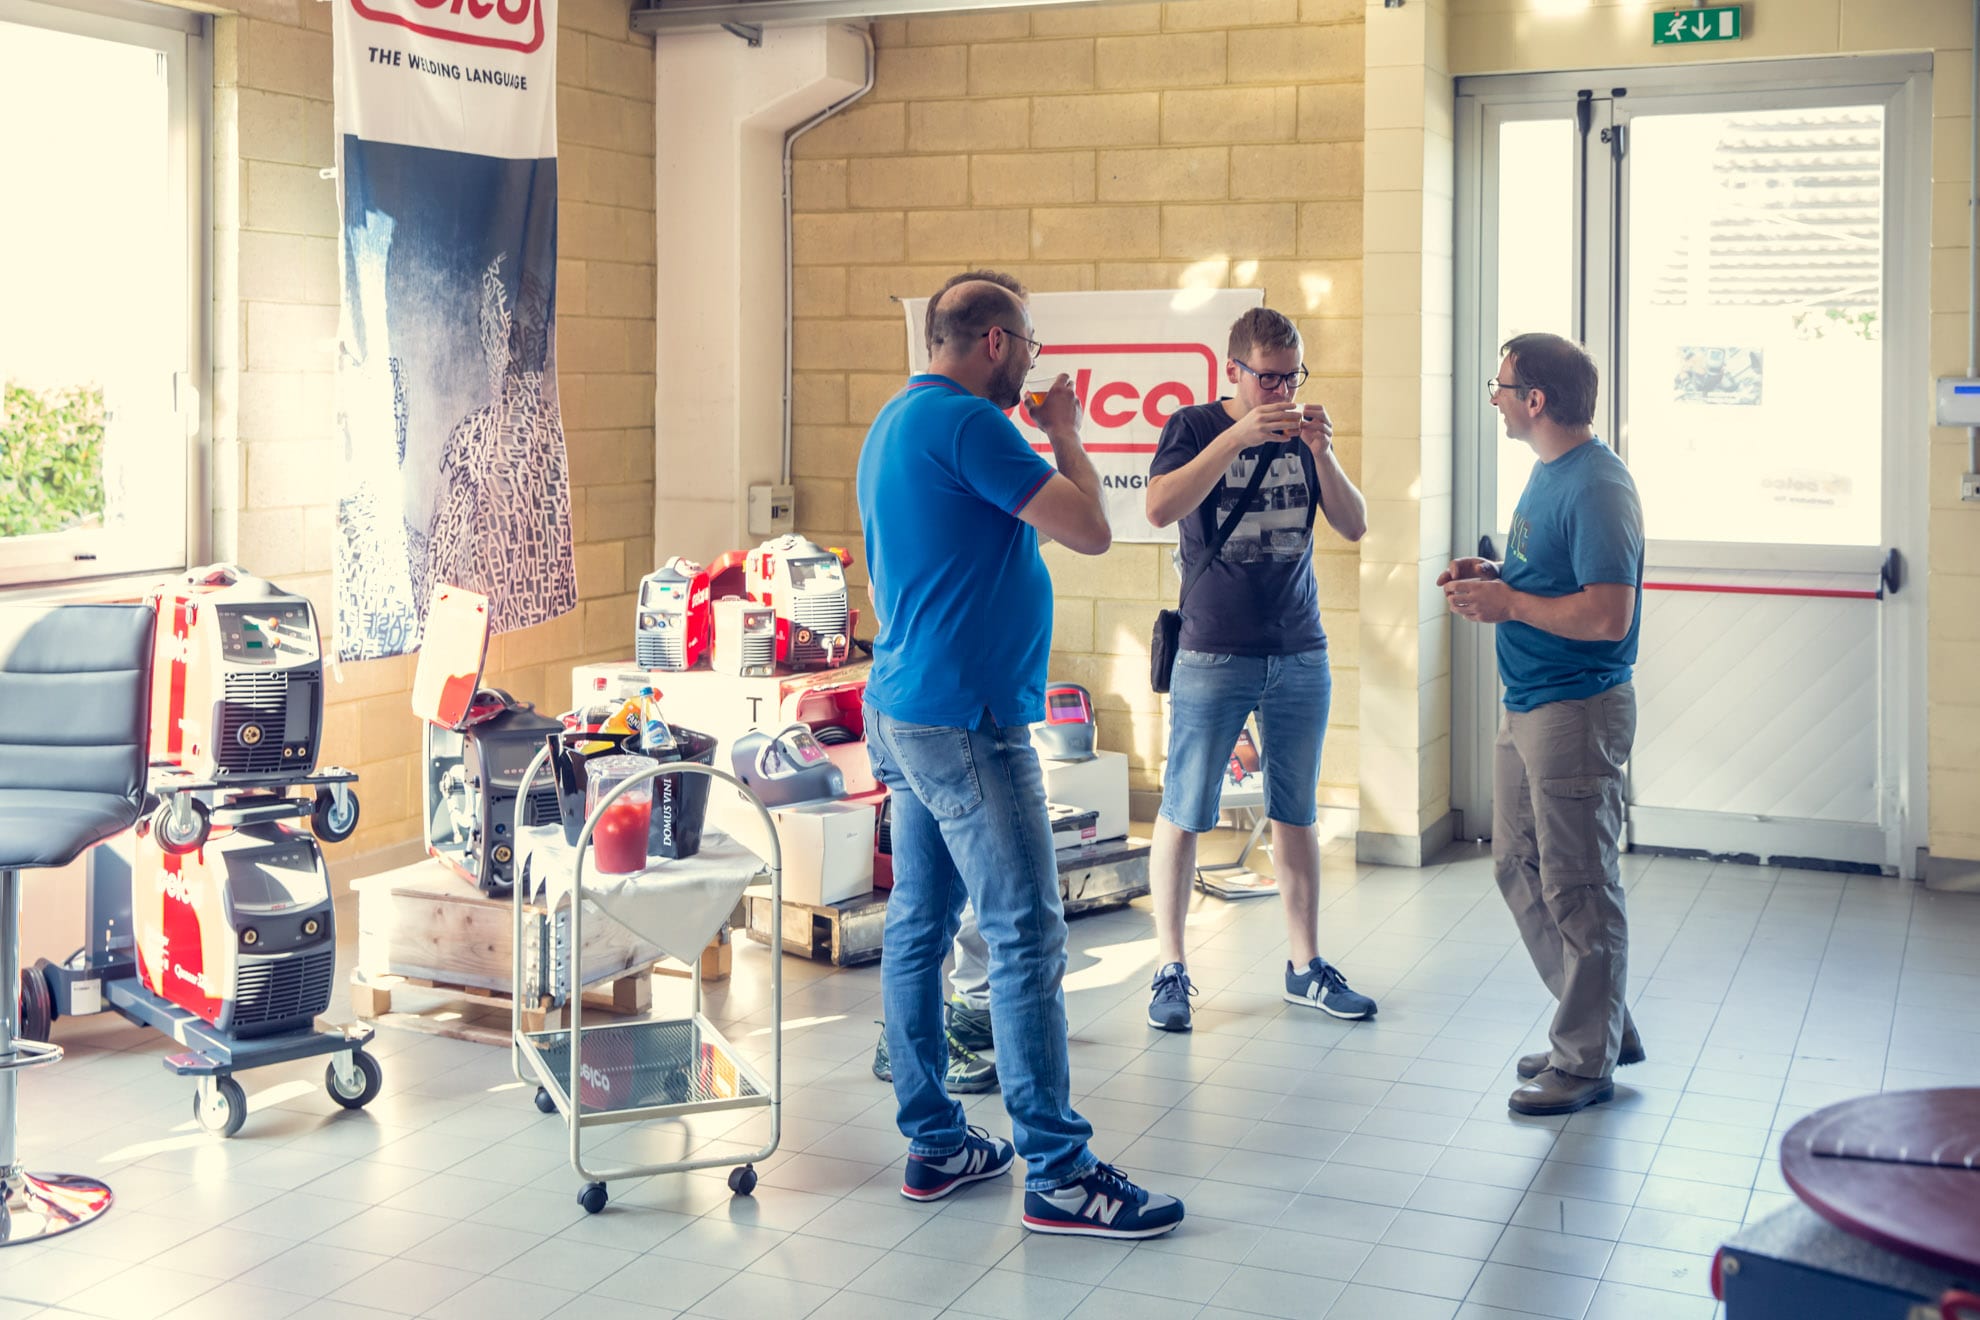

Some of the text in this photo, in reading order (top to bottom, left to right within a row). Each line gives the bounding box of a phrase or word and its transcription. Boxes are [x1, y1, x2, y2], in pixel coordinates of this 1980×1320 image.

[368, 47, 528, 91] THE WELDING LANGUAGE
[663, 778, 672, 847] DOMUS VINI
[966, 1149, 989, 1174] N
[1083, 1192, 1124, 1225] N
